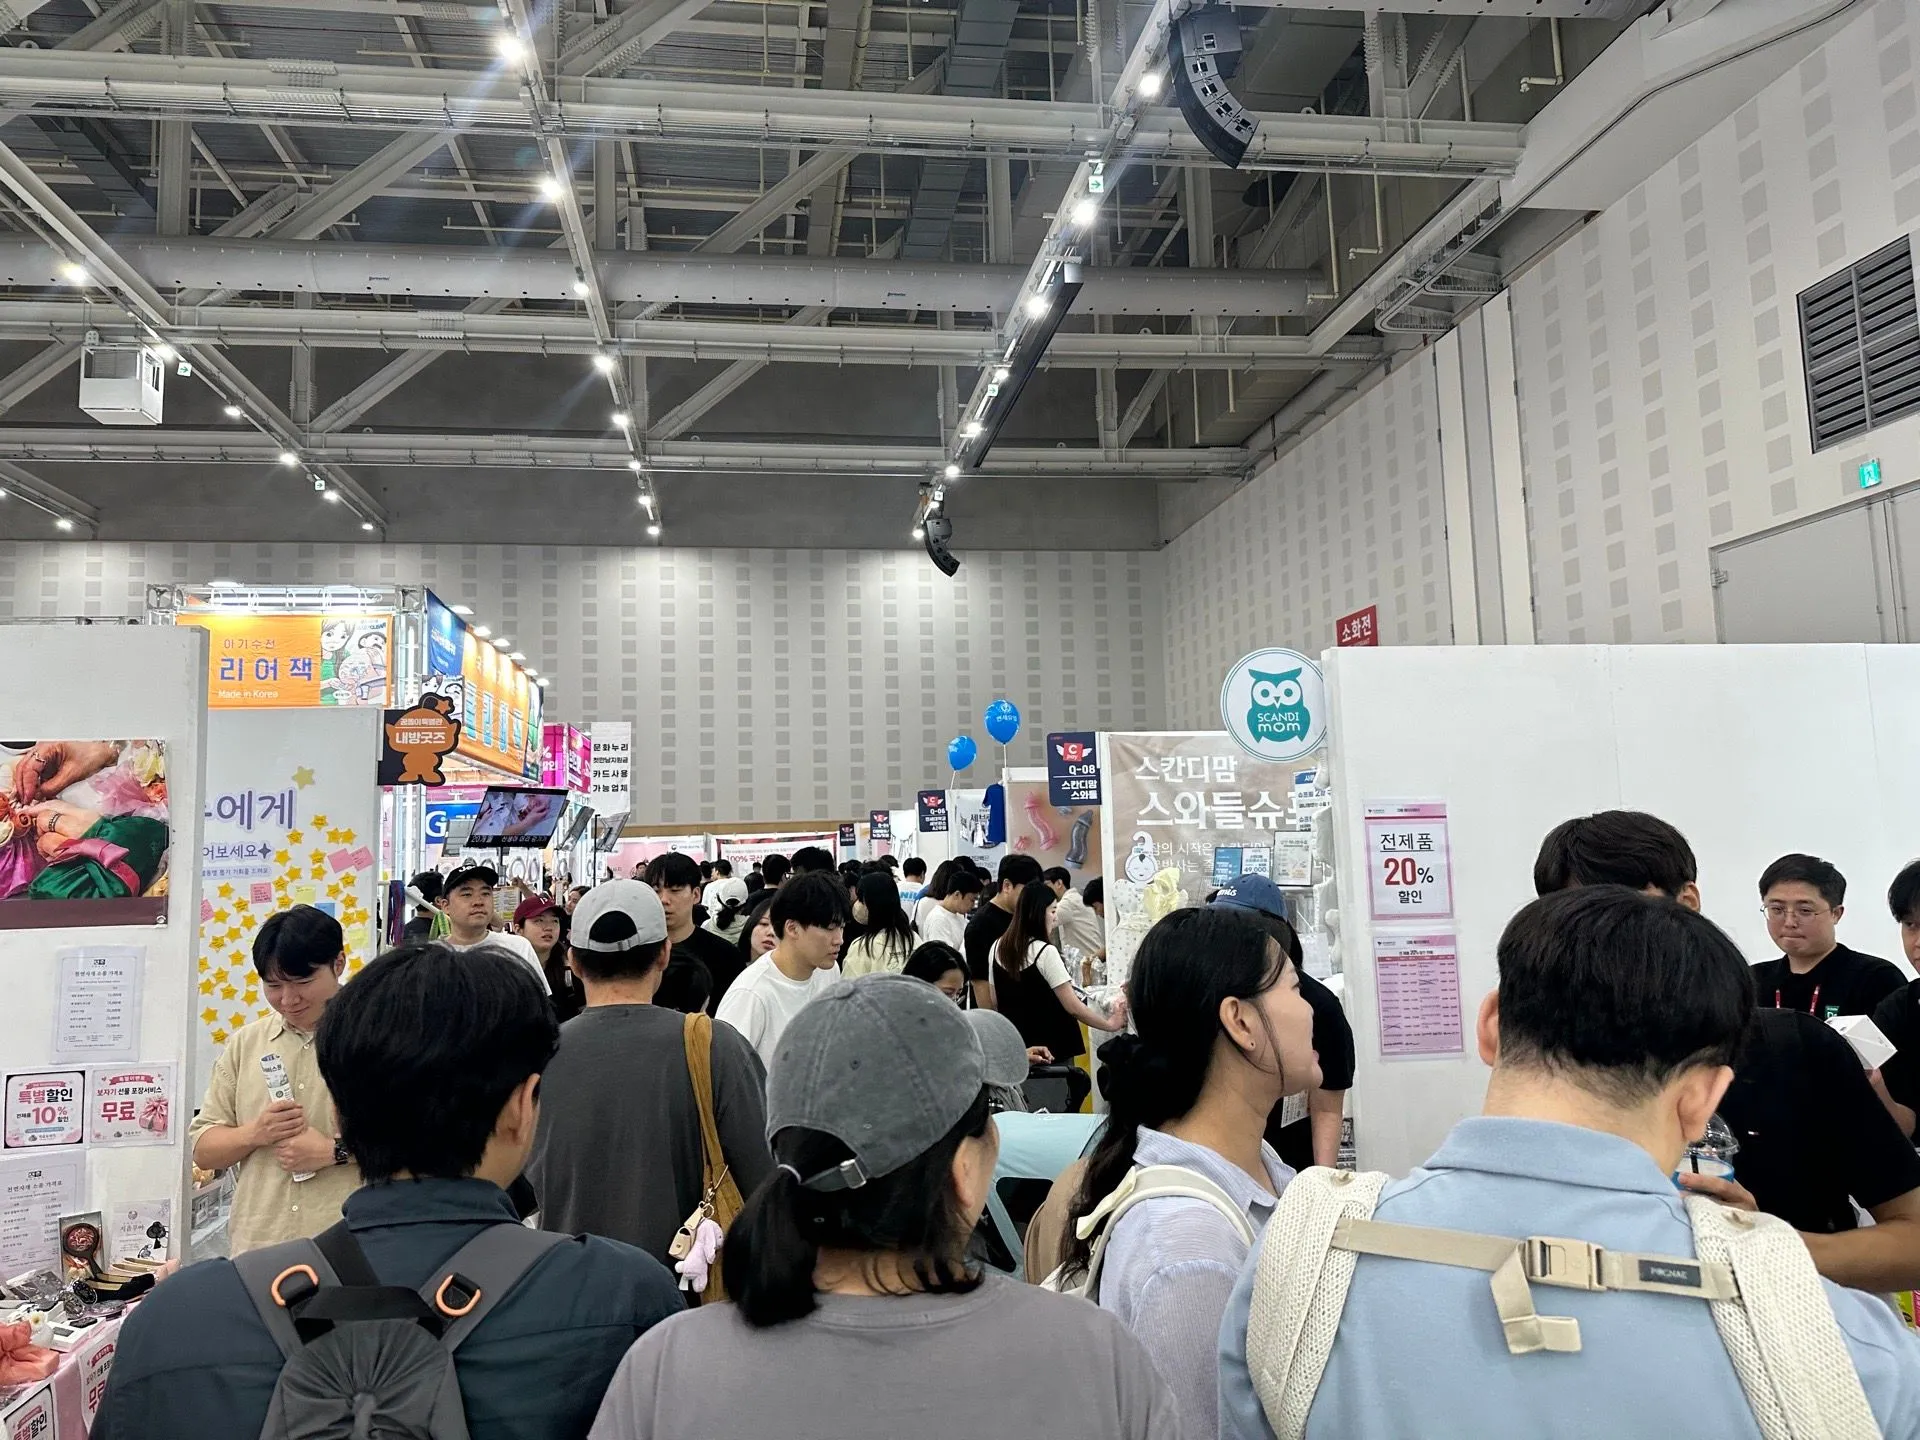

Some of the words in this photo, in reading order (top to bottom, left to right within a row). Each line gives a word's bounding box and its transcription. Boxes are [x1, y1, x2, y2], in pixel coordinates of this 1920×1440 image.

[1341, 614, 1371, 642] 소화전
[218, 690, 241, 699] Made
[244, 690, 251, 698] in
[253, 690, 278, 699] Korea
[1257, 711, 1299, 722] SCANDI
[1258, 722, 1300, 733] mom
[396, 731, 446, 745] 내방굿즈
[593, 743, 629, 752] 문화누리
[593, 769, 628, 778] 카드사용
[1068, 764, 1096, 775] Q-08
[1134, 755, 1238, 784] 스칸디맘
[593, 784, 628, 792] 가능업체
[1061, 779, 1098, 790] 스칸디맘
[1070, 789, 1098, 800] 스와들
[205, 789, 294, 831] 에게
[1380, 832, 1434, 850] 전제품
[1178, 841, 1215, 857] 시작은
[1383, 857, 1435, 886] 20%
[1397, 889, 1423, 904] 할인
[18, 1088, 73, 1104] 특별할인
[97, 1087, 117, 1096] 보자기
[118, 1087, 130, 1095] 선물
[131, 1086, 162, 1095] 포장서비스
[32, 1106, 68, 1124] 10%
[101, 1101, 136, 1122] 무료
